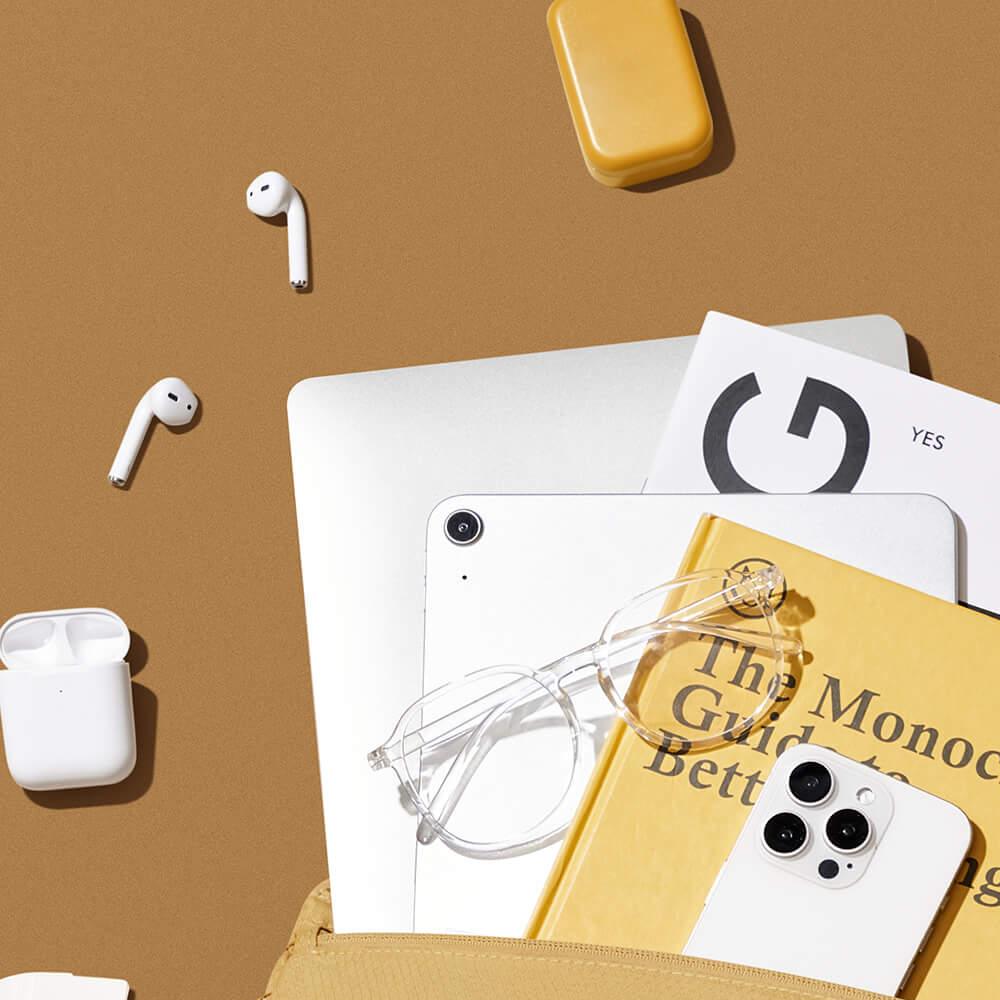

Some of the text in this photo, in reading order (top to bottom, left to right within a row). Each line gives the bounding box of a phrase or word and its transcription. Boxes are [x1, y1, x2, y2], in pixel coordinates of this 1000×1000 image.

[911, 425, 945, 451] YES
[694, 632, 797, 703] The
[671, 683, 817, 758] Guid
[642, 728, 766, 807] Bett
